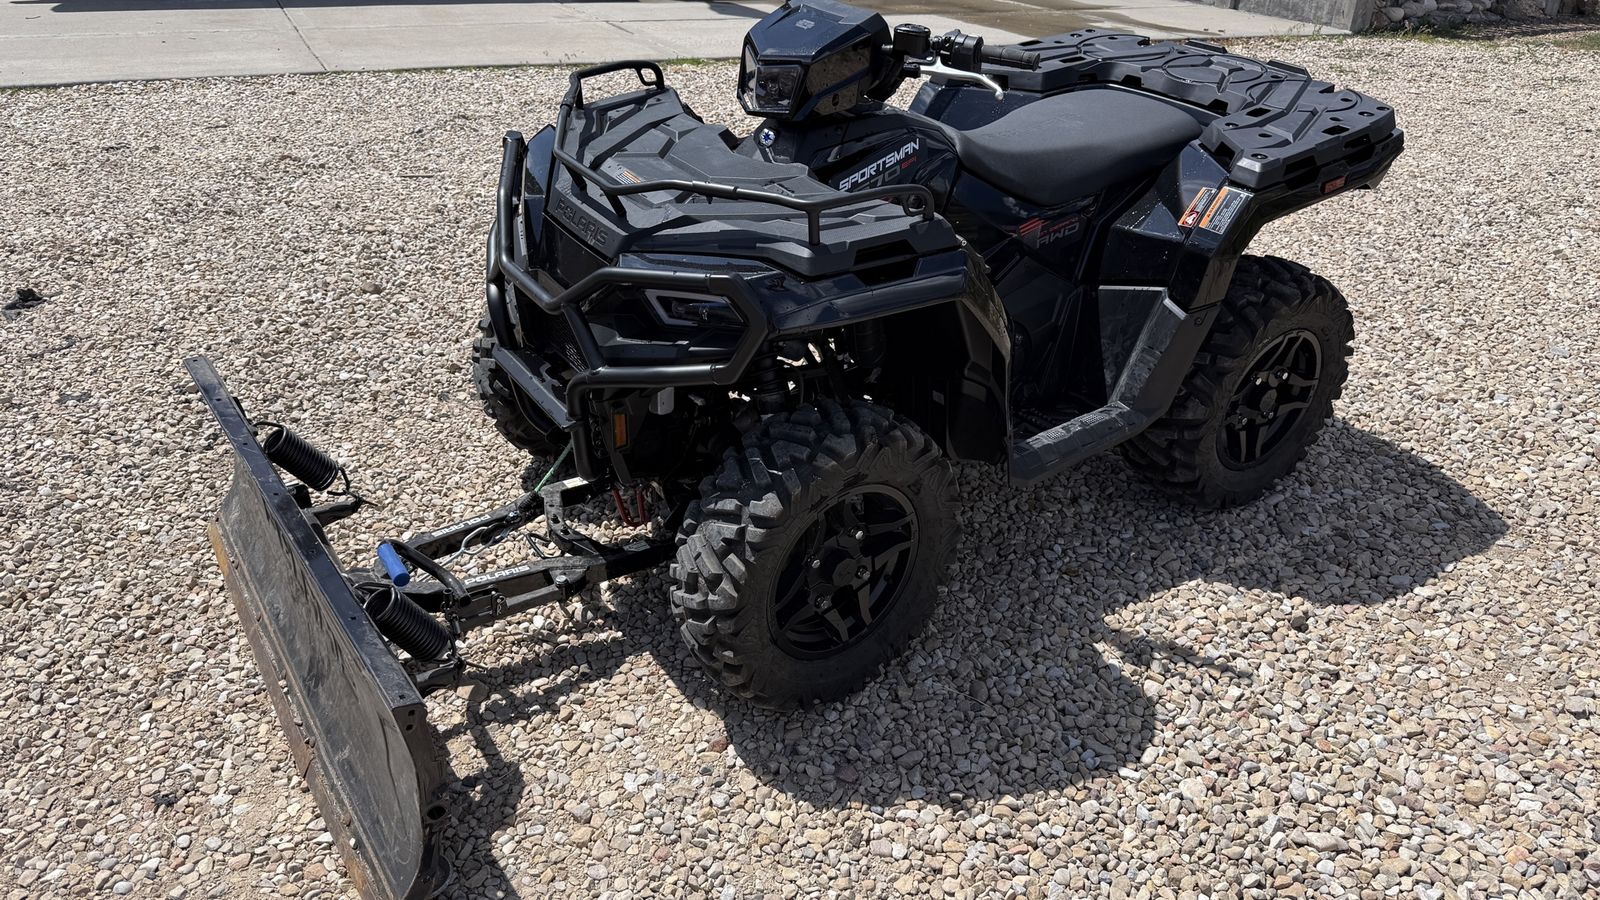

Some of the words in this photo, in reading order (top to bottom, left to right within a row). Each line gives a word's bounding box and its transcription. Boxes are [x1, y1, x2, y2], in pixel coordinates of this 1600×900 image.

[839, 138, 919, 192] SPORTSMAN
[556, 199, 608, 246] POLARIS
[431, 514, 491, 537] POLARIS
[464, 565, 530, 585] POLARIS
